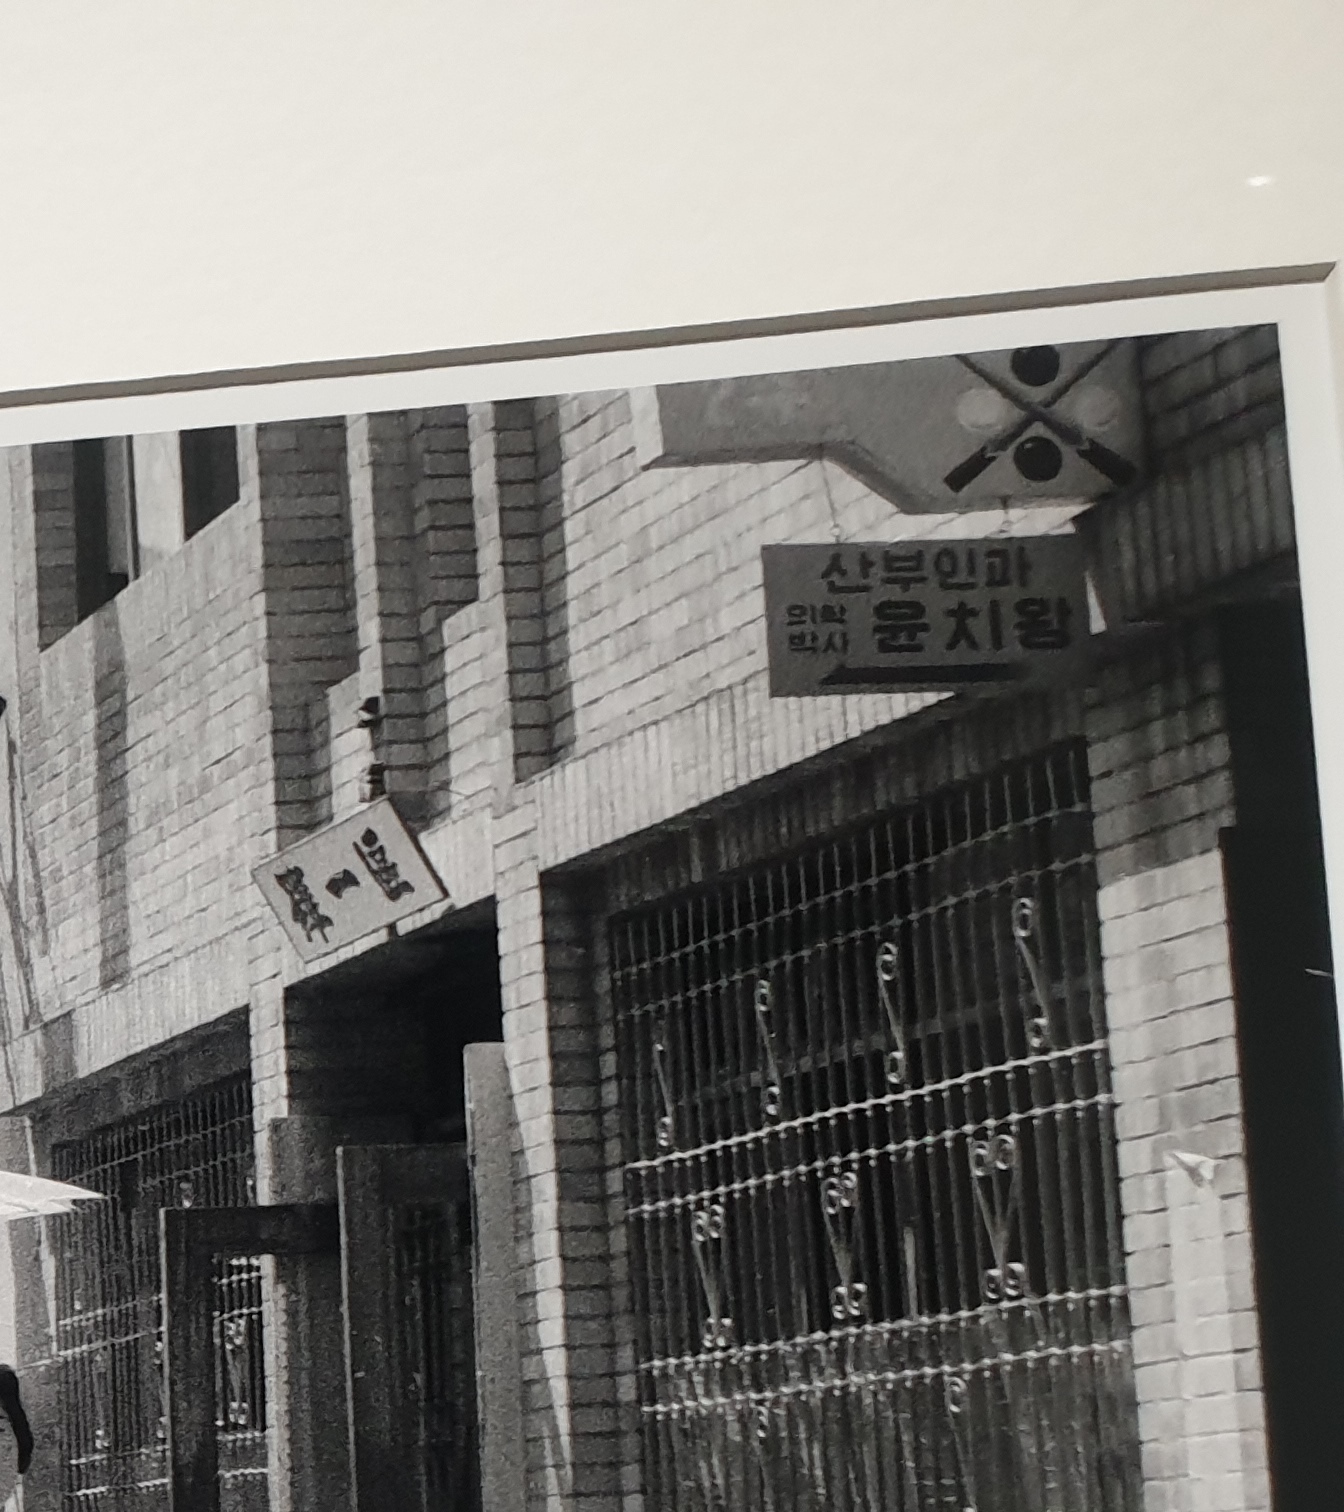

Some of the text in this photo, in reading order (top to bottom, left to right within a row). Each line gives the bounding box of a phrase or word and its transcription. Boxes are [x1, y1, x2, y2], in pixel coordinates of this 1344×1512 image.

[820, 546, 1032, 594] 산부인과
[787, 630, 849, 654] 박사
[872, 597, 1073, 653] 윤치왕
